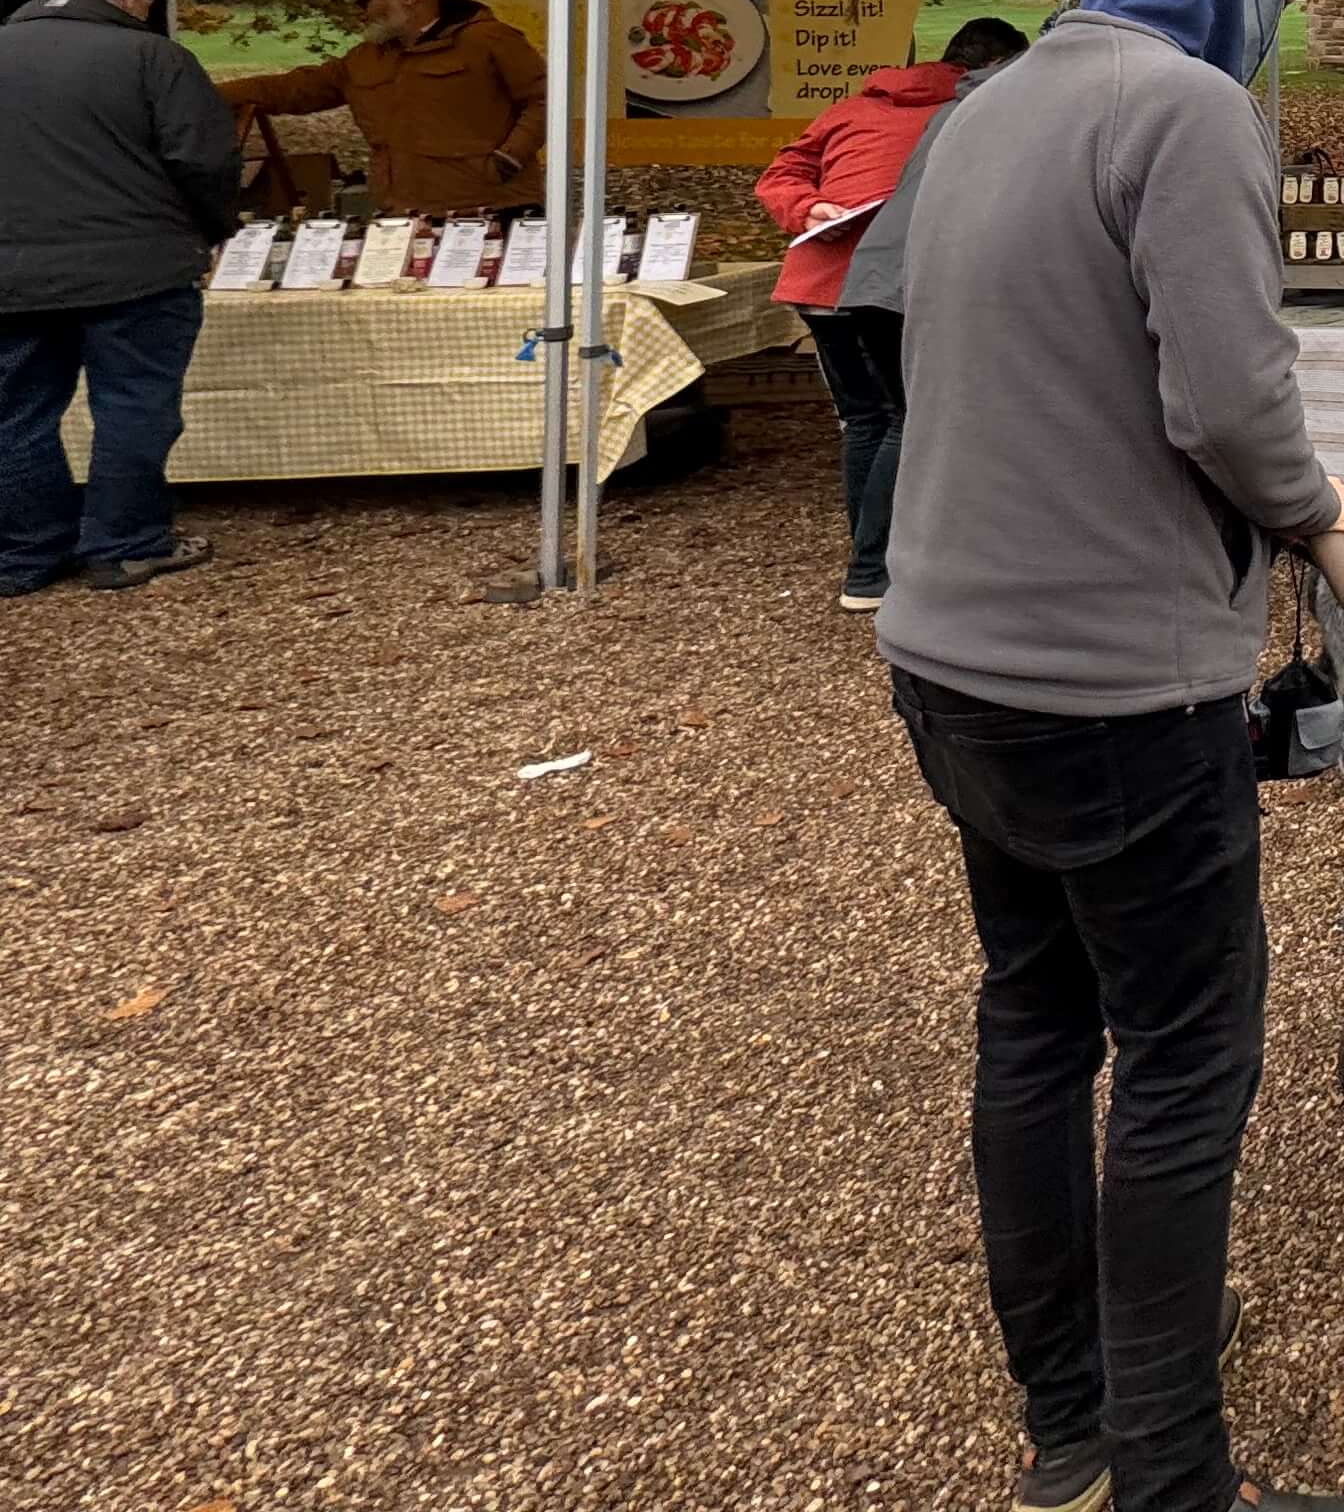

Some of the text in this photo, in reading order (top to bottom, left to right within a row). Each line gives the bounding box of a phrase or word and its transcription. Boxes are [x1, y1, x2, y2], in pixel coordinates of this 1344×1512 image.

[794, 0, 884, 17] Sizzl it!
[795, 29, 857, 52] Dip it!
[796, 59, 889, 76] Love eve
[796, 82, 849, 104] drop!
